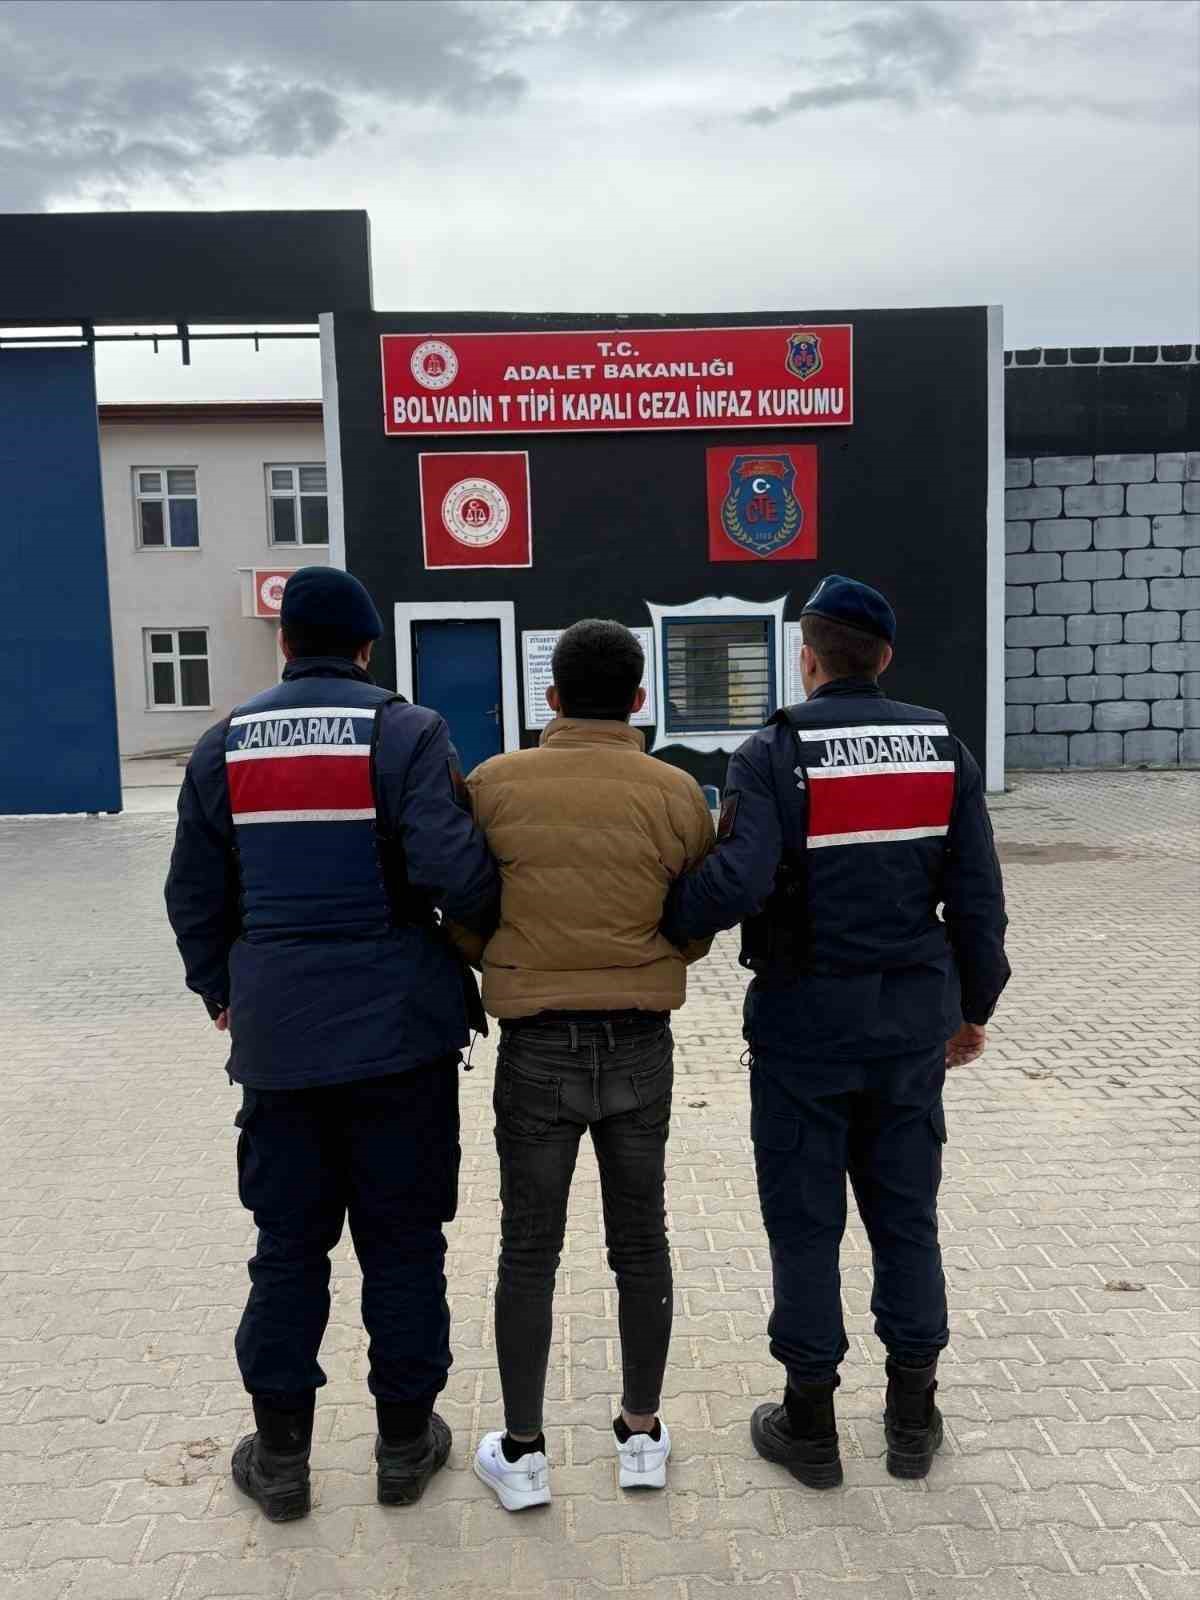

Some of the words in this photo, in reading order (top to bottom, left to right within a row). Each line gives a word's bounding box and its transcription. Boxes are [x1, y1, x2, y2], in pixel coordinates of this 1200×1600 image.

[597, 342, 639, 357] T.C.
[503, 364, 596, 381] ADALET
[603, 358, 734, 379] BAKANLIĞI
[393, 389, 493, 424] BOLVADİN
[499, 395, 511, 423] T
[517, 388, 556, 422] TİPİ
[562, 393, 632, 421] KAPALI
[638, 391, 691, 419] CEZA
[696, 385, 752, 418] İNFAZ
[758, 387, 844, 417] KURUMU
[237, 717, 356, 750] JANDARMA
[820, 735, 939, 767] JANDARMA
